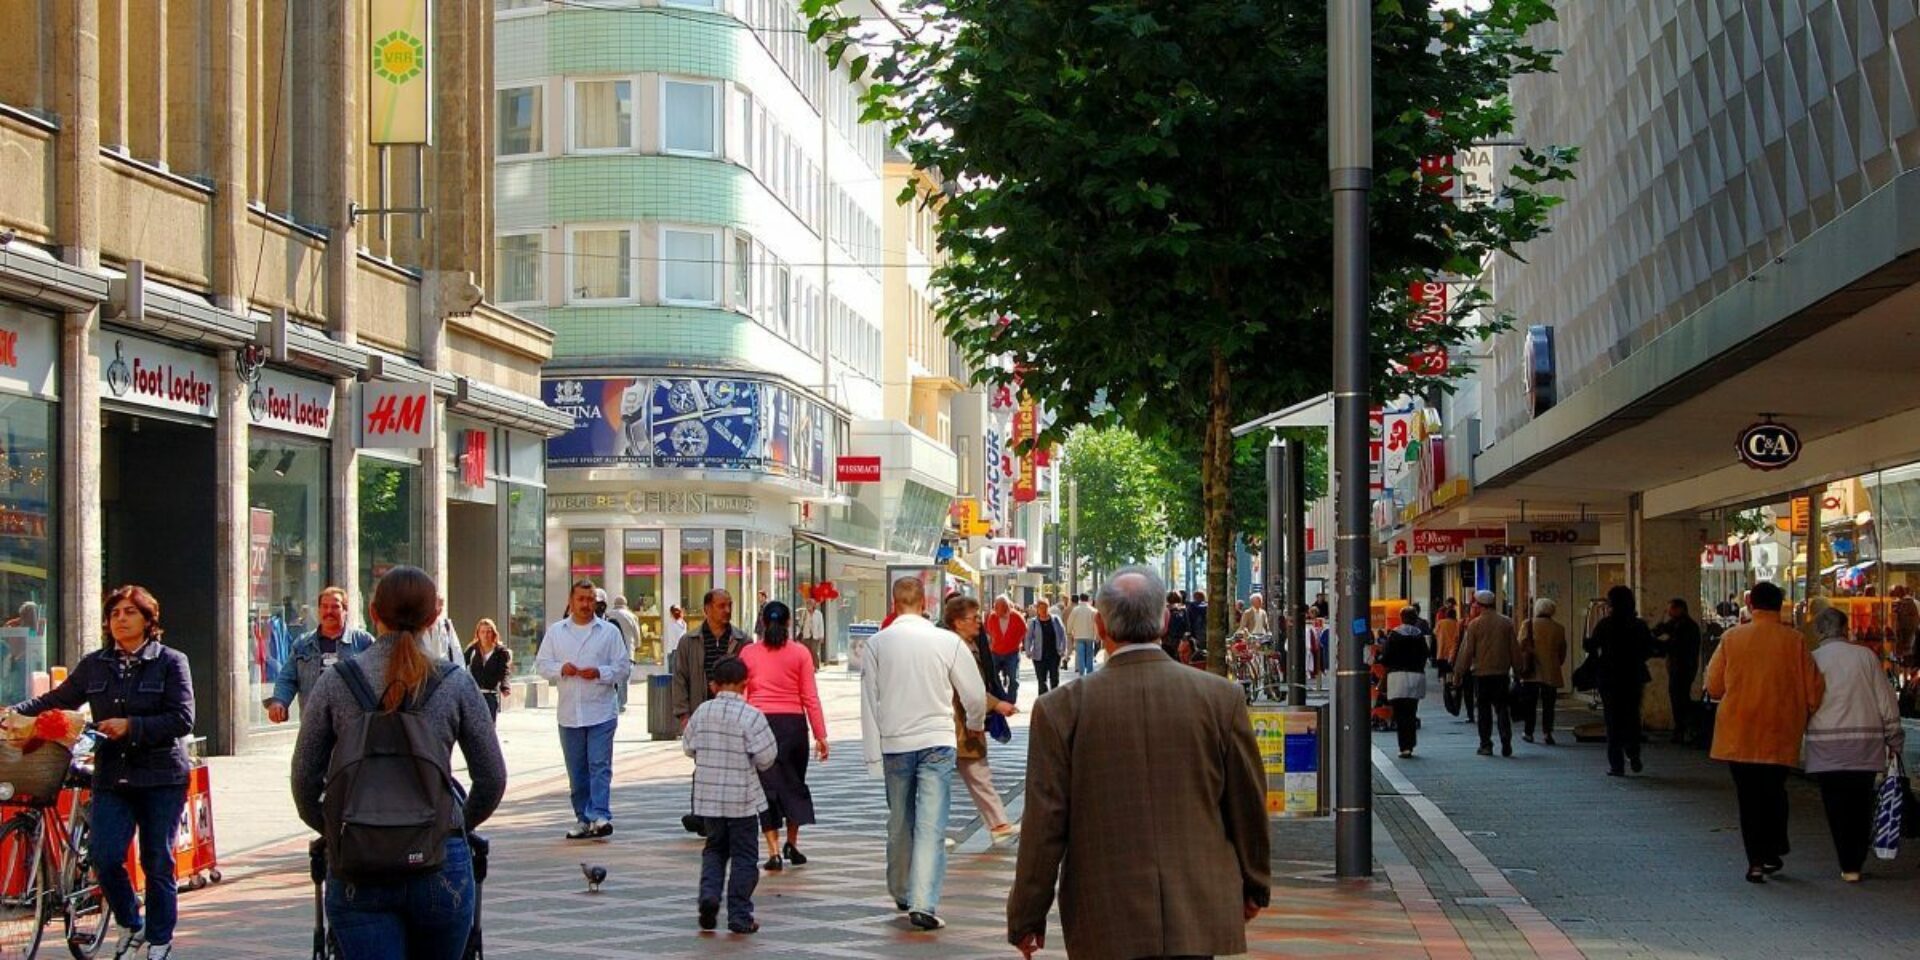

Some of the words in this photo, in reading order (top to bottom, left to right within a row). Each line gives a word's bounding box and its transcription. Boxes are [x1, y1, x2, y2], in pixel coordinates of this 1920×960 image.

[384, 52, 412, 64] VRR
[133, 358, 163, 398] Foot
[168, 365, 212, 407] Locker
[268, 387, 291, 422] Foot
[295, 393, 329, 430] Locker
[368, 394, 427, 435] H&M
[1750, 434, 1791, 455] C&A
[1529, 529, 1578, 543] RENO
